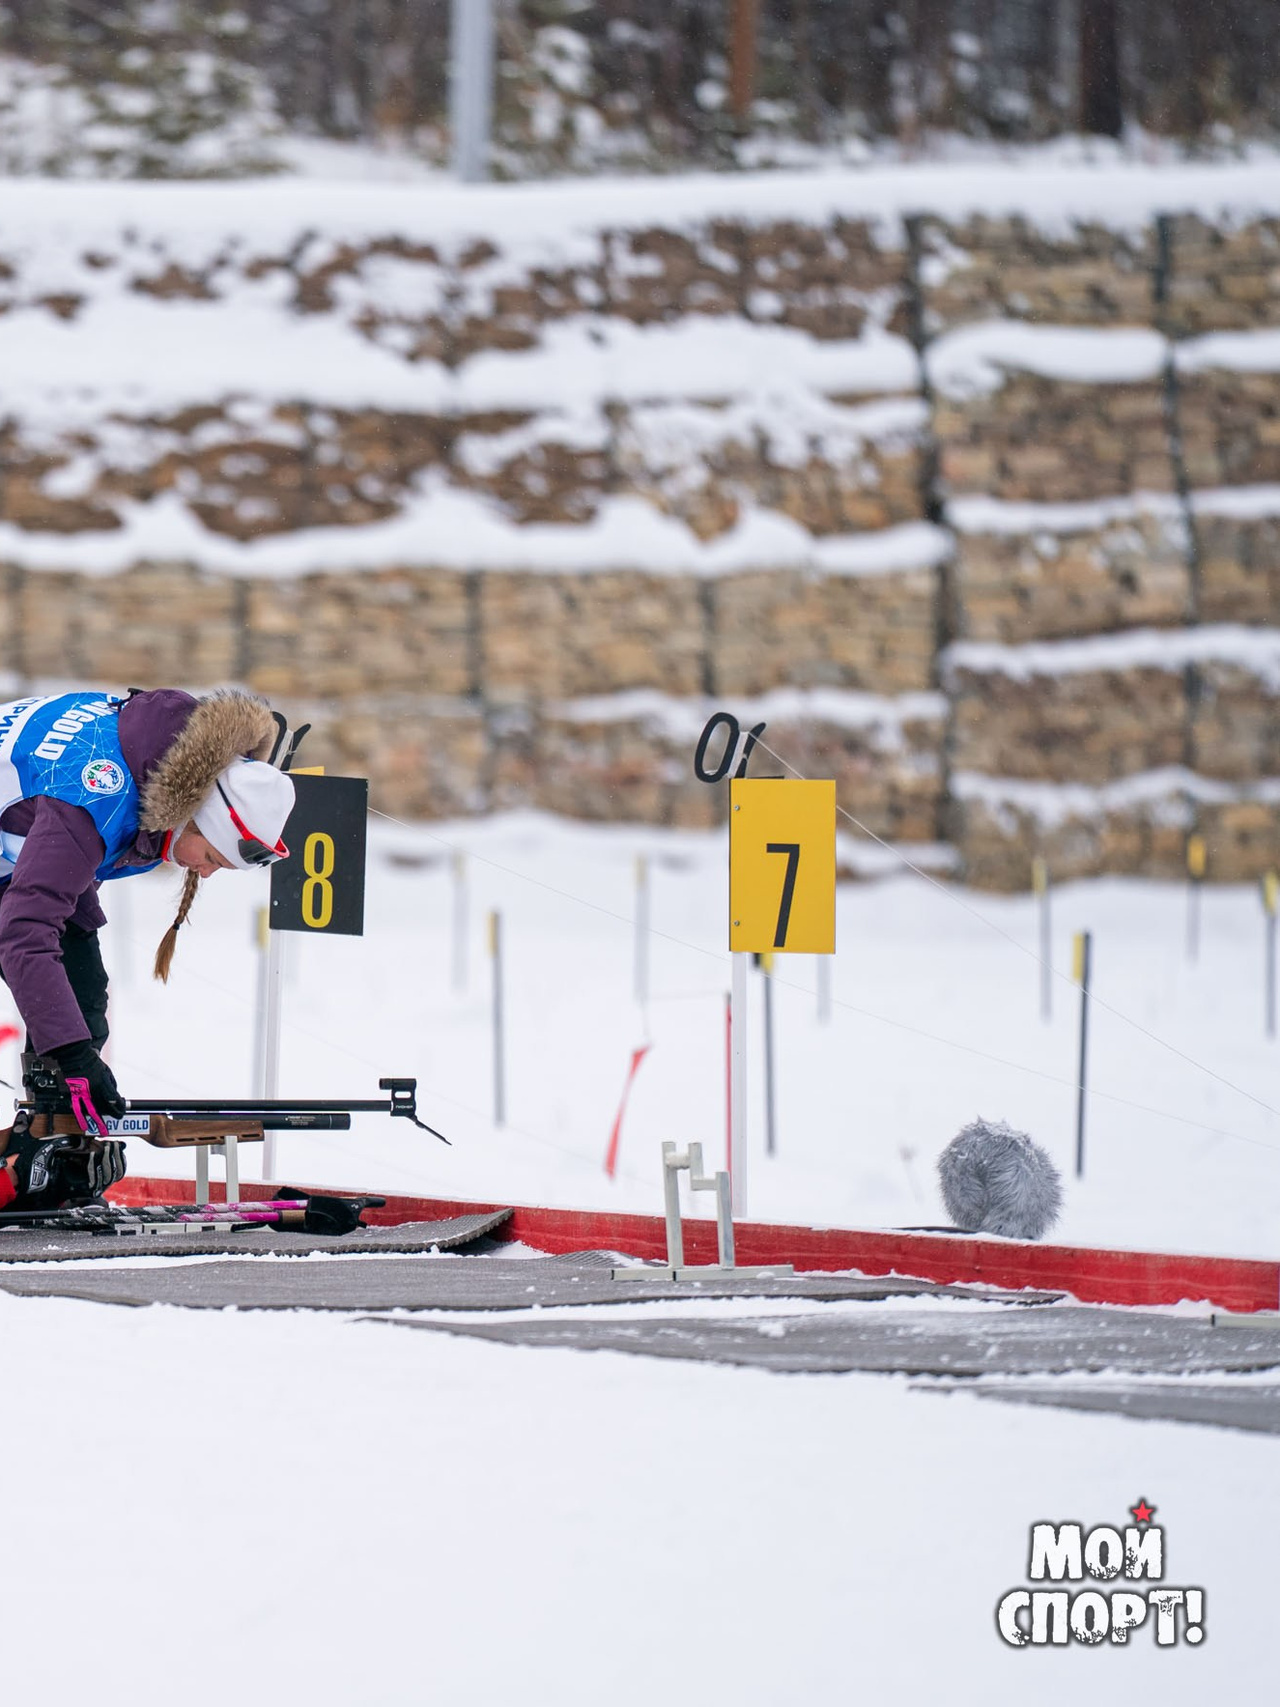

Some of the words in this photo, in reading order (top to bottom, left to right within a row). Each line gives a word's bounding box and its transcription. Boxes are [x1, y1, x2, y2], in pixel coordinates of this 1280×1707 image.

[301, 832, 335, 928] 8
[766, 843, 800, 948] 7
[106, 1119, 120, 1131] GV
[122, 1119, 149, 1131] GOLD
